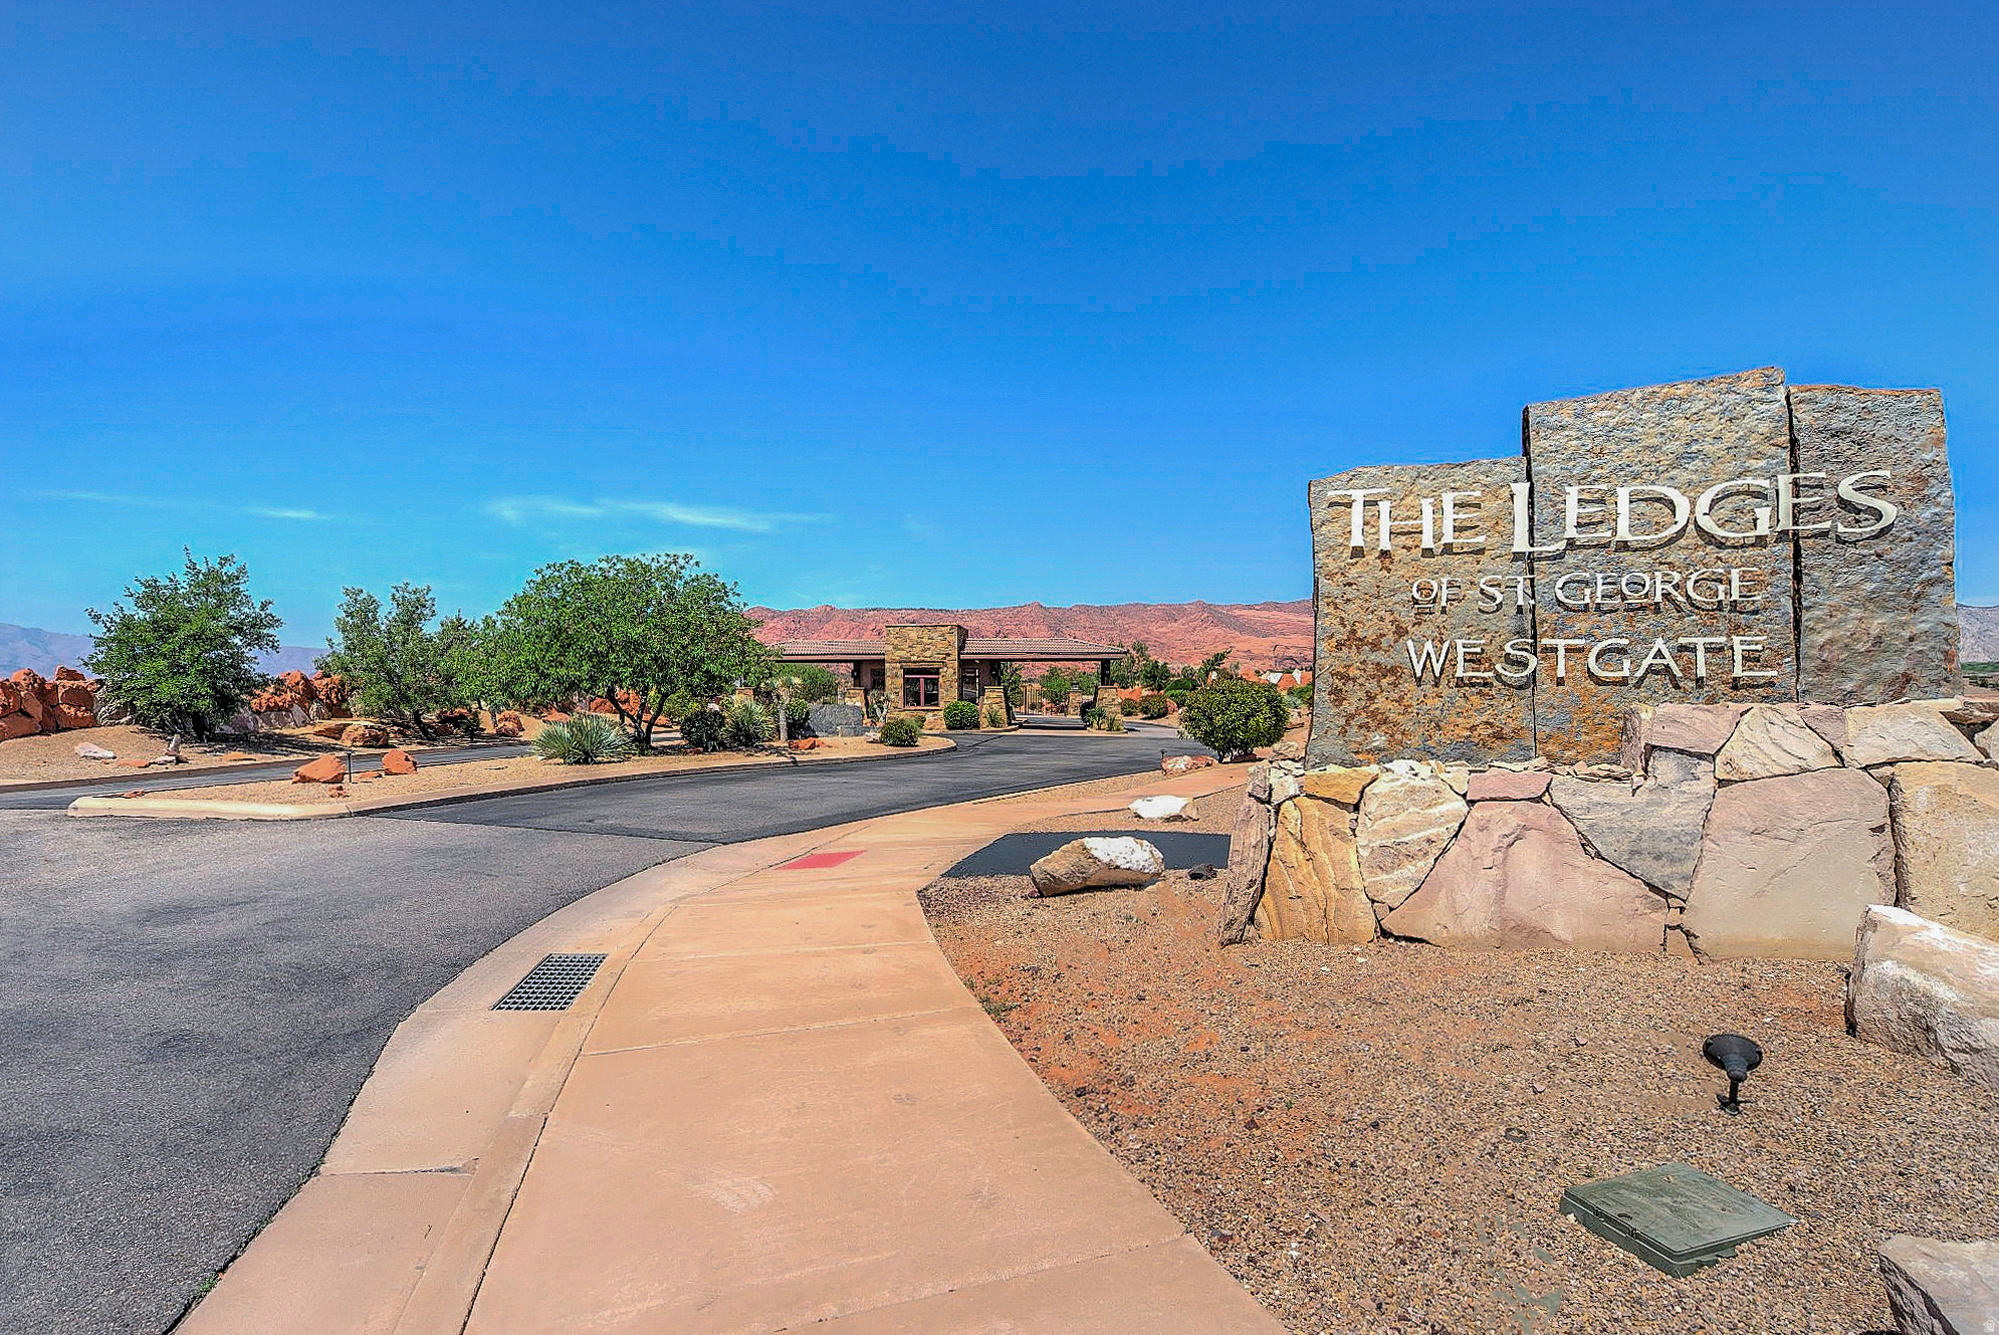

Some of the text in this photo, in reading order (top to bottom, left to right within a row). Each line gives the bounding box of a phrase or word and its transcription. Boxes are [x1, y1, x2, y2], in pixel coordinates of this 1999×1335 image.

[1327, 470, 1899, 554] THE LEDGES
[1411, 578, 1463, 609] OF
[1553, 567, 1763, 606] GEORGE
[1405, 635, 1779, 680] WESTGATE
